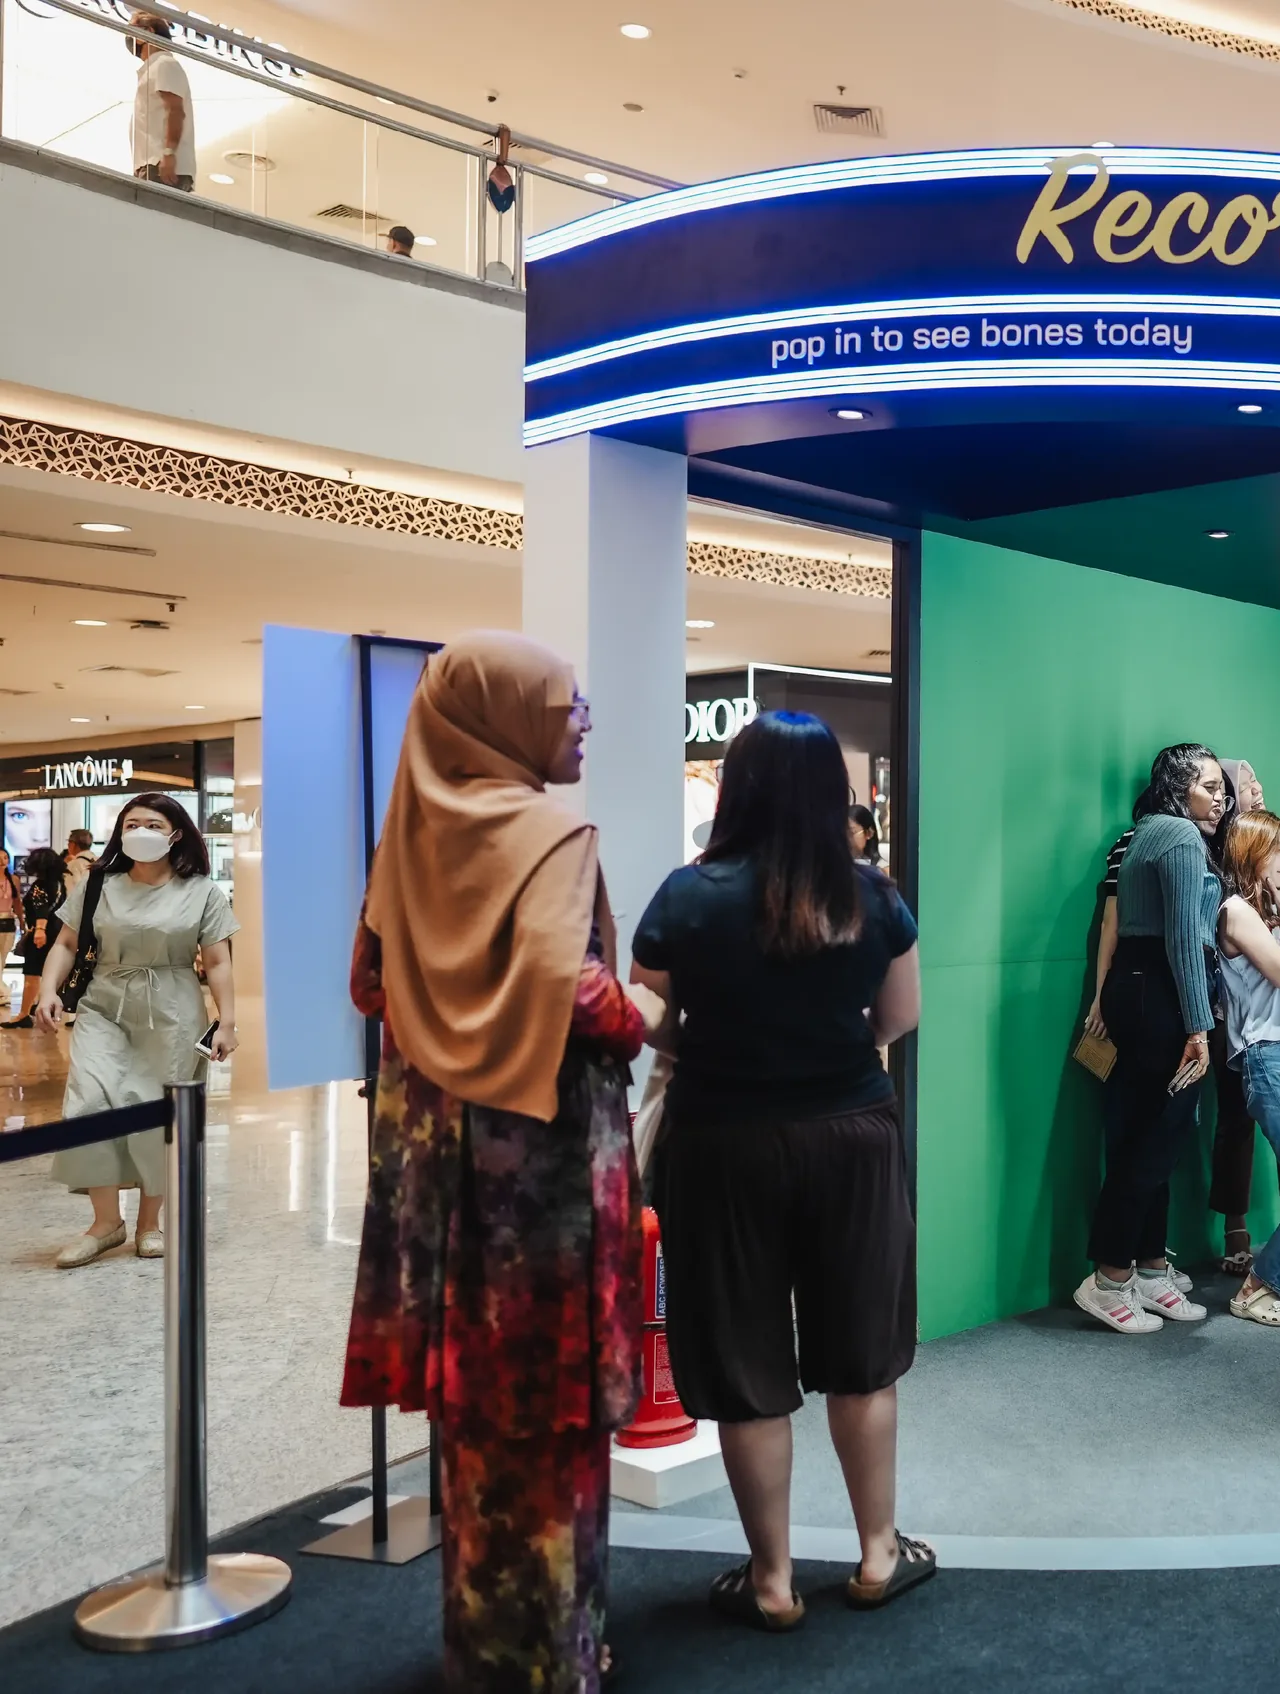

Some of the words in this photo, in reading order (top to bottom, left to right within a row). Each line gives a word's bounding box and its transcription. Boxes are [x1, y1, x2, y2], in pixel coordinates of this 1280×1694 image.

[771, 335, 826, 369] pop
[834, 327, 862, 355] in
[871, 325, 904, 352] to
[912, 325, 970, 350] see
[981, 317, 1084, 347] bones
[1093, 316, 1193, 355] today
[45, 756, 118, 790] LANCÔME
[658, 1296, 666, 1315] ABC
